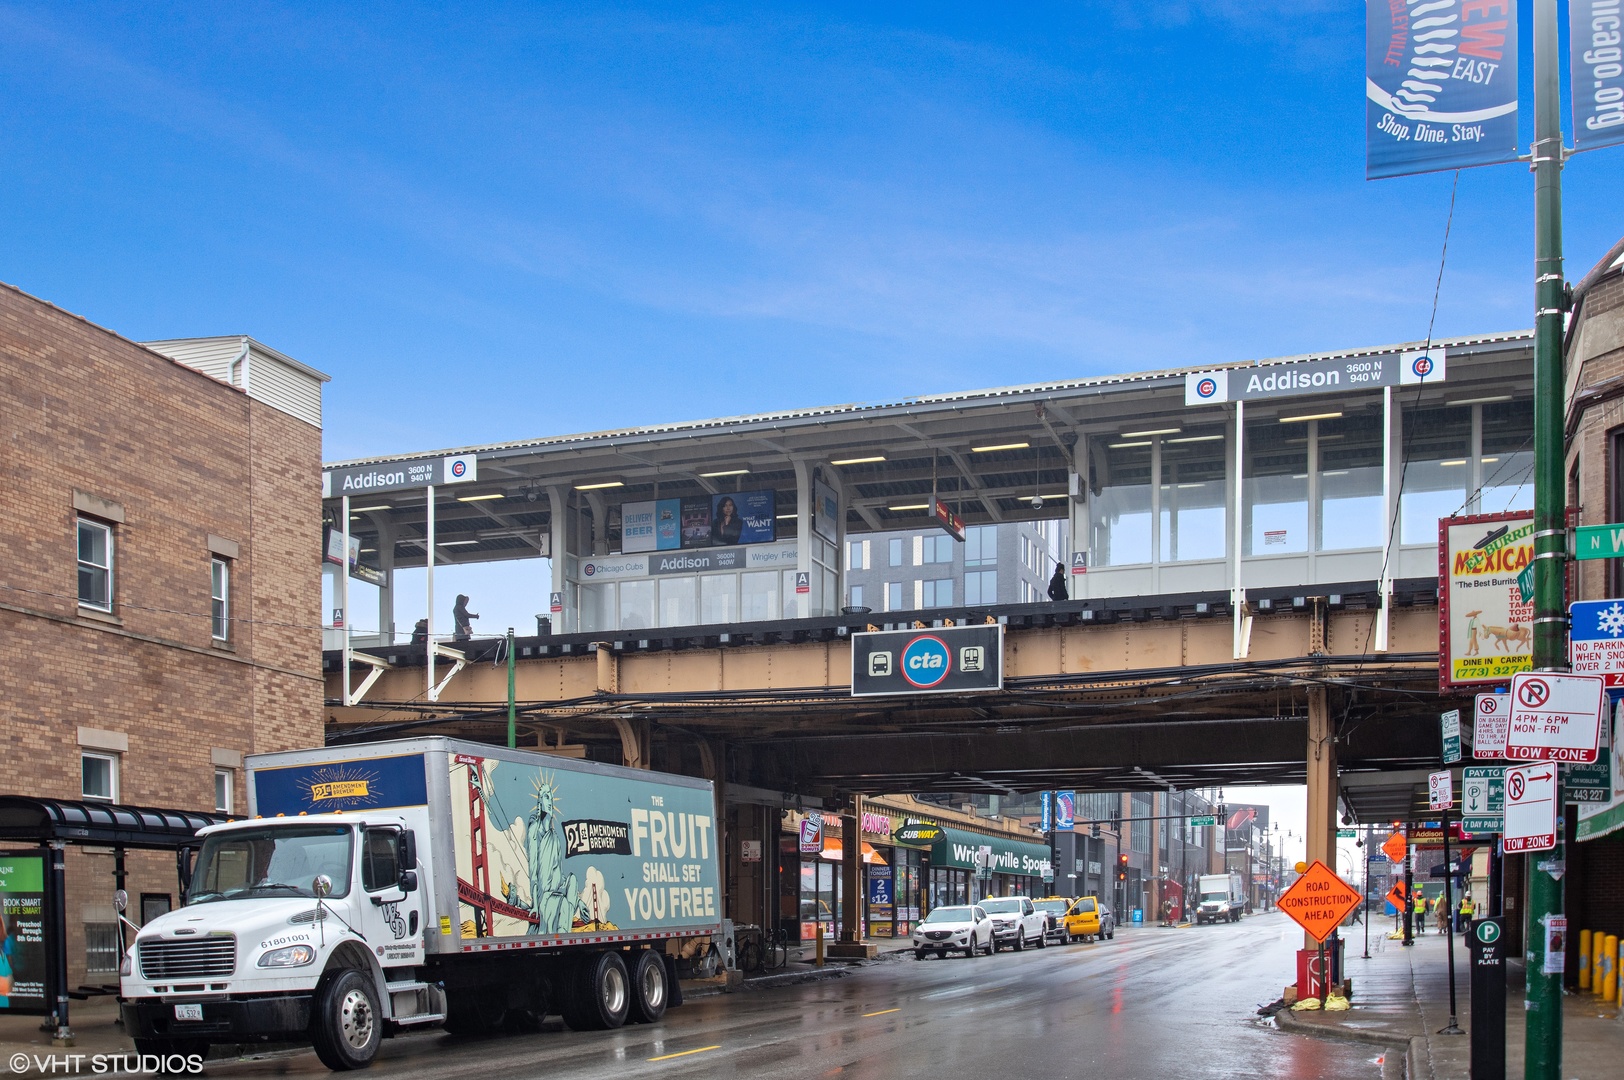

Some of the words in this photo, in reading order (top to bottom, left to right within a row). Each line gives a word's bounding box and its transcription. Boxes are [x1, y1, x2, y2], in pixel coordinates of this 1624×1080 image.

[1451, 57, 1499, 85] EAST
[1376, 113, 1410, 141] Shop,
[1414, 124, 1448, 143] Dine,
[1452, 124, 1485, 142] Stay.
[1346, 362, 1371, 373] 3600
[1373, 361, 1382, 371] N
[1246, 369, 1340, 393] Addison
[1350, 372, 1369, 383] 940
[1371, 371, 1382, 381] W
[408, 466, 425, 475] 3600
[426, 464, 433, 472] N
[342, 471, 405, 490] Addison
[410, 474, 424, 482] 940
[625, 513, 653, 524] DELIVERY
[746, 519, 772, 528] WANT
[625, 526, 653, 536] BEER
[1591, 535, 1600, 550] N
[752, 552, 778, 562] Wrigley
[1075, 553, 1084, 564] A
[1465, 553, 1485, 571] EL
[596, 565, 624, 574] Chicago
[625, 563, 644, 571] Cubs
[660, 556, 710, 571] Addison
[798, 573, 808, 583] A
[1473, 579, 1491, 587] Best
[552, 593, 560, 603] A
[335, 609, 342, 619] A
[1576, 643, 1588, 652] NO
[909, 653, 943, 670] cta
[1463, 658, 1482, 666] DINE
[1484, 657, 1493, 665] IN
[1500, 656, 1528, 664] CARRY
[1576, 652, 1602, 661] WHEN
[1576, 662, 1599, 671] OVER
[1605, 661, 1611, 670] 2
[1455, 666, 1489, 678] (773)
[1514, 724, 1535, 733] MON
[1543, 725, 1560, 734] FRI
[1511, 747, 1542, 758] TOW
[1548, 748, 1588, 761] ZONE
[1469, 769, 1485, 777] PAY
[1487, 769, 1500, 777] TO
[1573, 789, 1588, 800] 443
[1589, 790, 1604, 800] 227
[651, 796, 664, 807] THE
[590, 824, 627, 838] AMENDMENT
[631, 808, 711, 860] FRUIT
[901, 829, 940, 839] SUBWAY
[590, 837, 616, 849] BREWERY
[1506, 839, 1524, 850] TOW
[1527, 835, 1550, 848] ZONE
[642, 862, 680, 883] SHALL
[682, 864, 701, 883] SET
[877, 880, 885, 890] 2
[1306, 881, 1330, 892] ROAD
[3, 898, 20, 907] BOOK
[21, 898, 41, 907] SMART
[624, 888, 666, 921] YOU
[670, 887, 715, 919] FREE
[872, 895, 888, 904] $12
[1285, 894, 1352, 908] CONSTRUCTION
[3, 907, 8, 915] &
[9, 907, 21, 915] LIFE
[22, 907, 42, 915] SMART
[1304, 910, 1335, 921] AHEAD
[260, 934, 310, 949] 61801001
